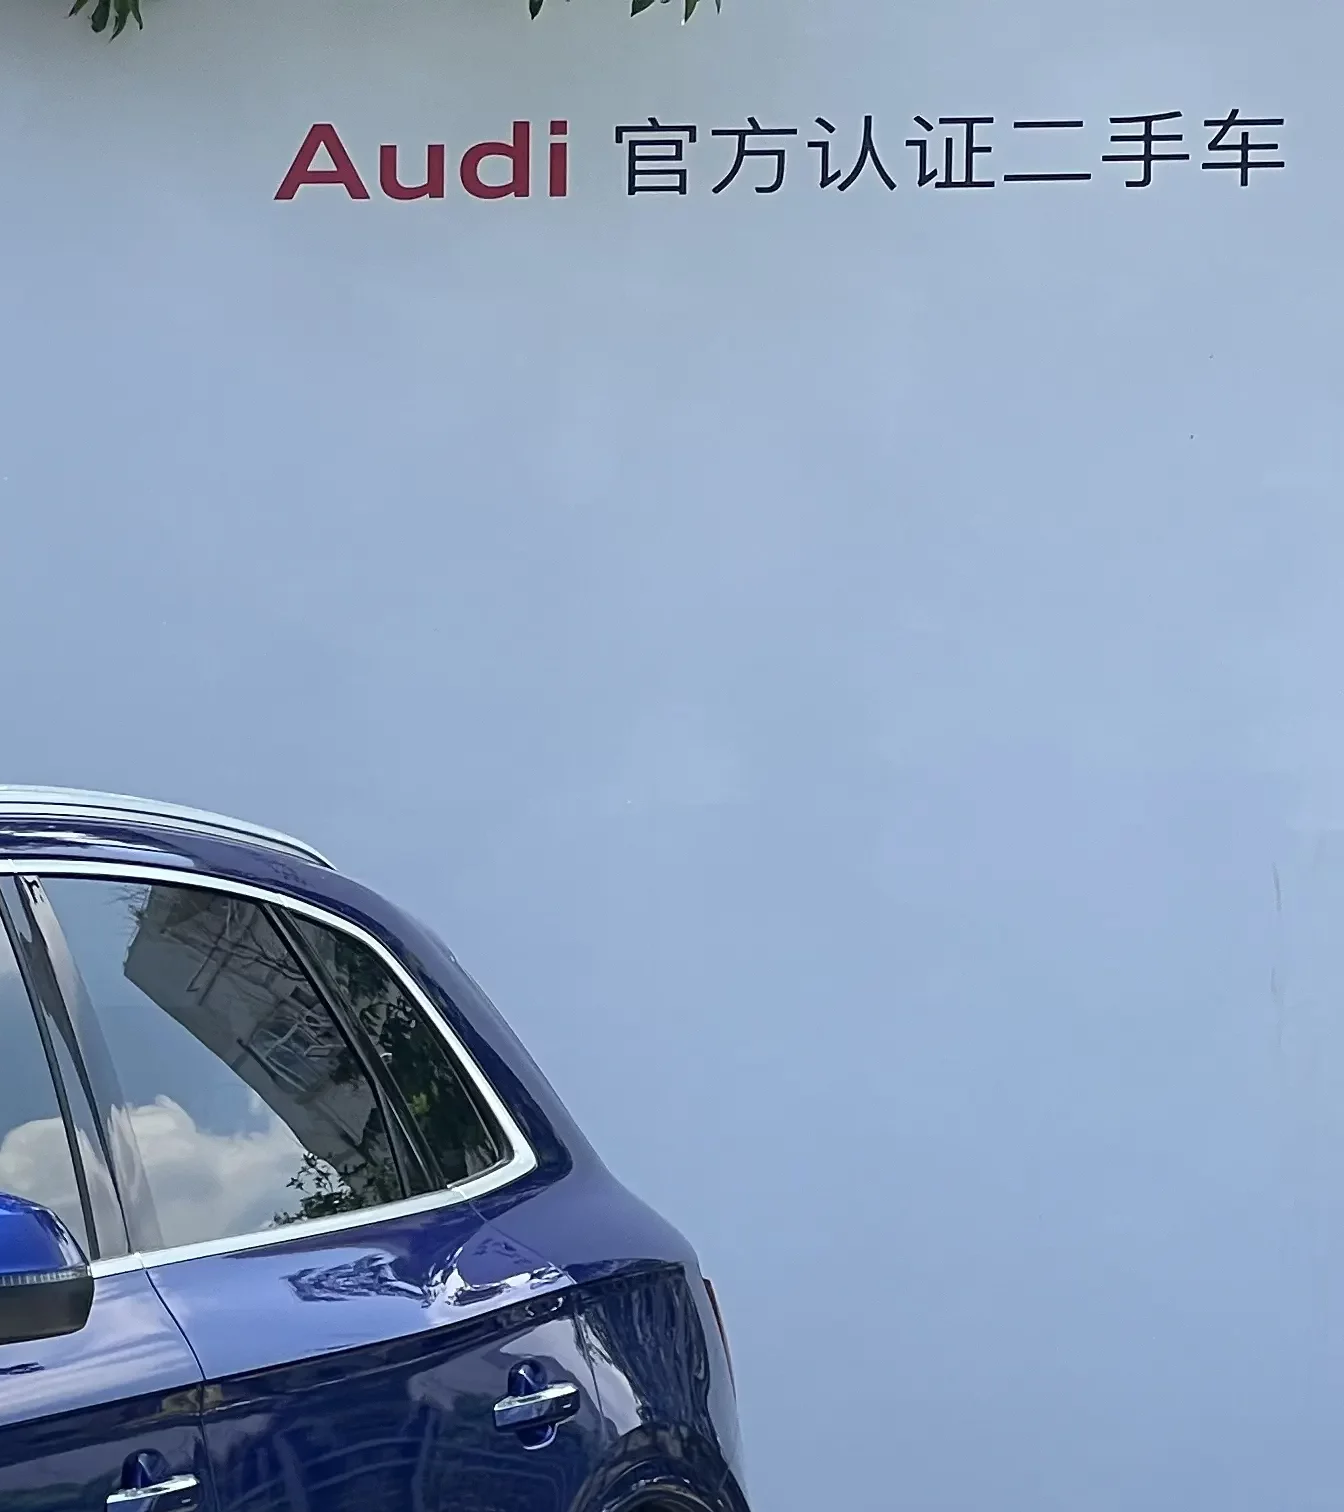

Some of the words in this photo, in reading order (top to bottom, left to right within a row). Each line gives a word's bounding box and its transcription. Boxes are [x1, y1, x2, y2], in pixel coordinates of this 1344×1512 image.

[273, 119, 569, 202] Audi
[613, 107, 1288, 198] 官方认证二手车
